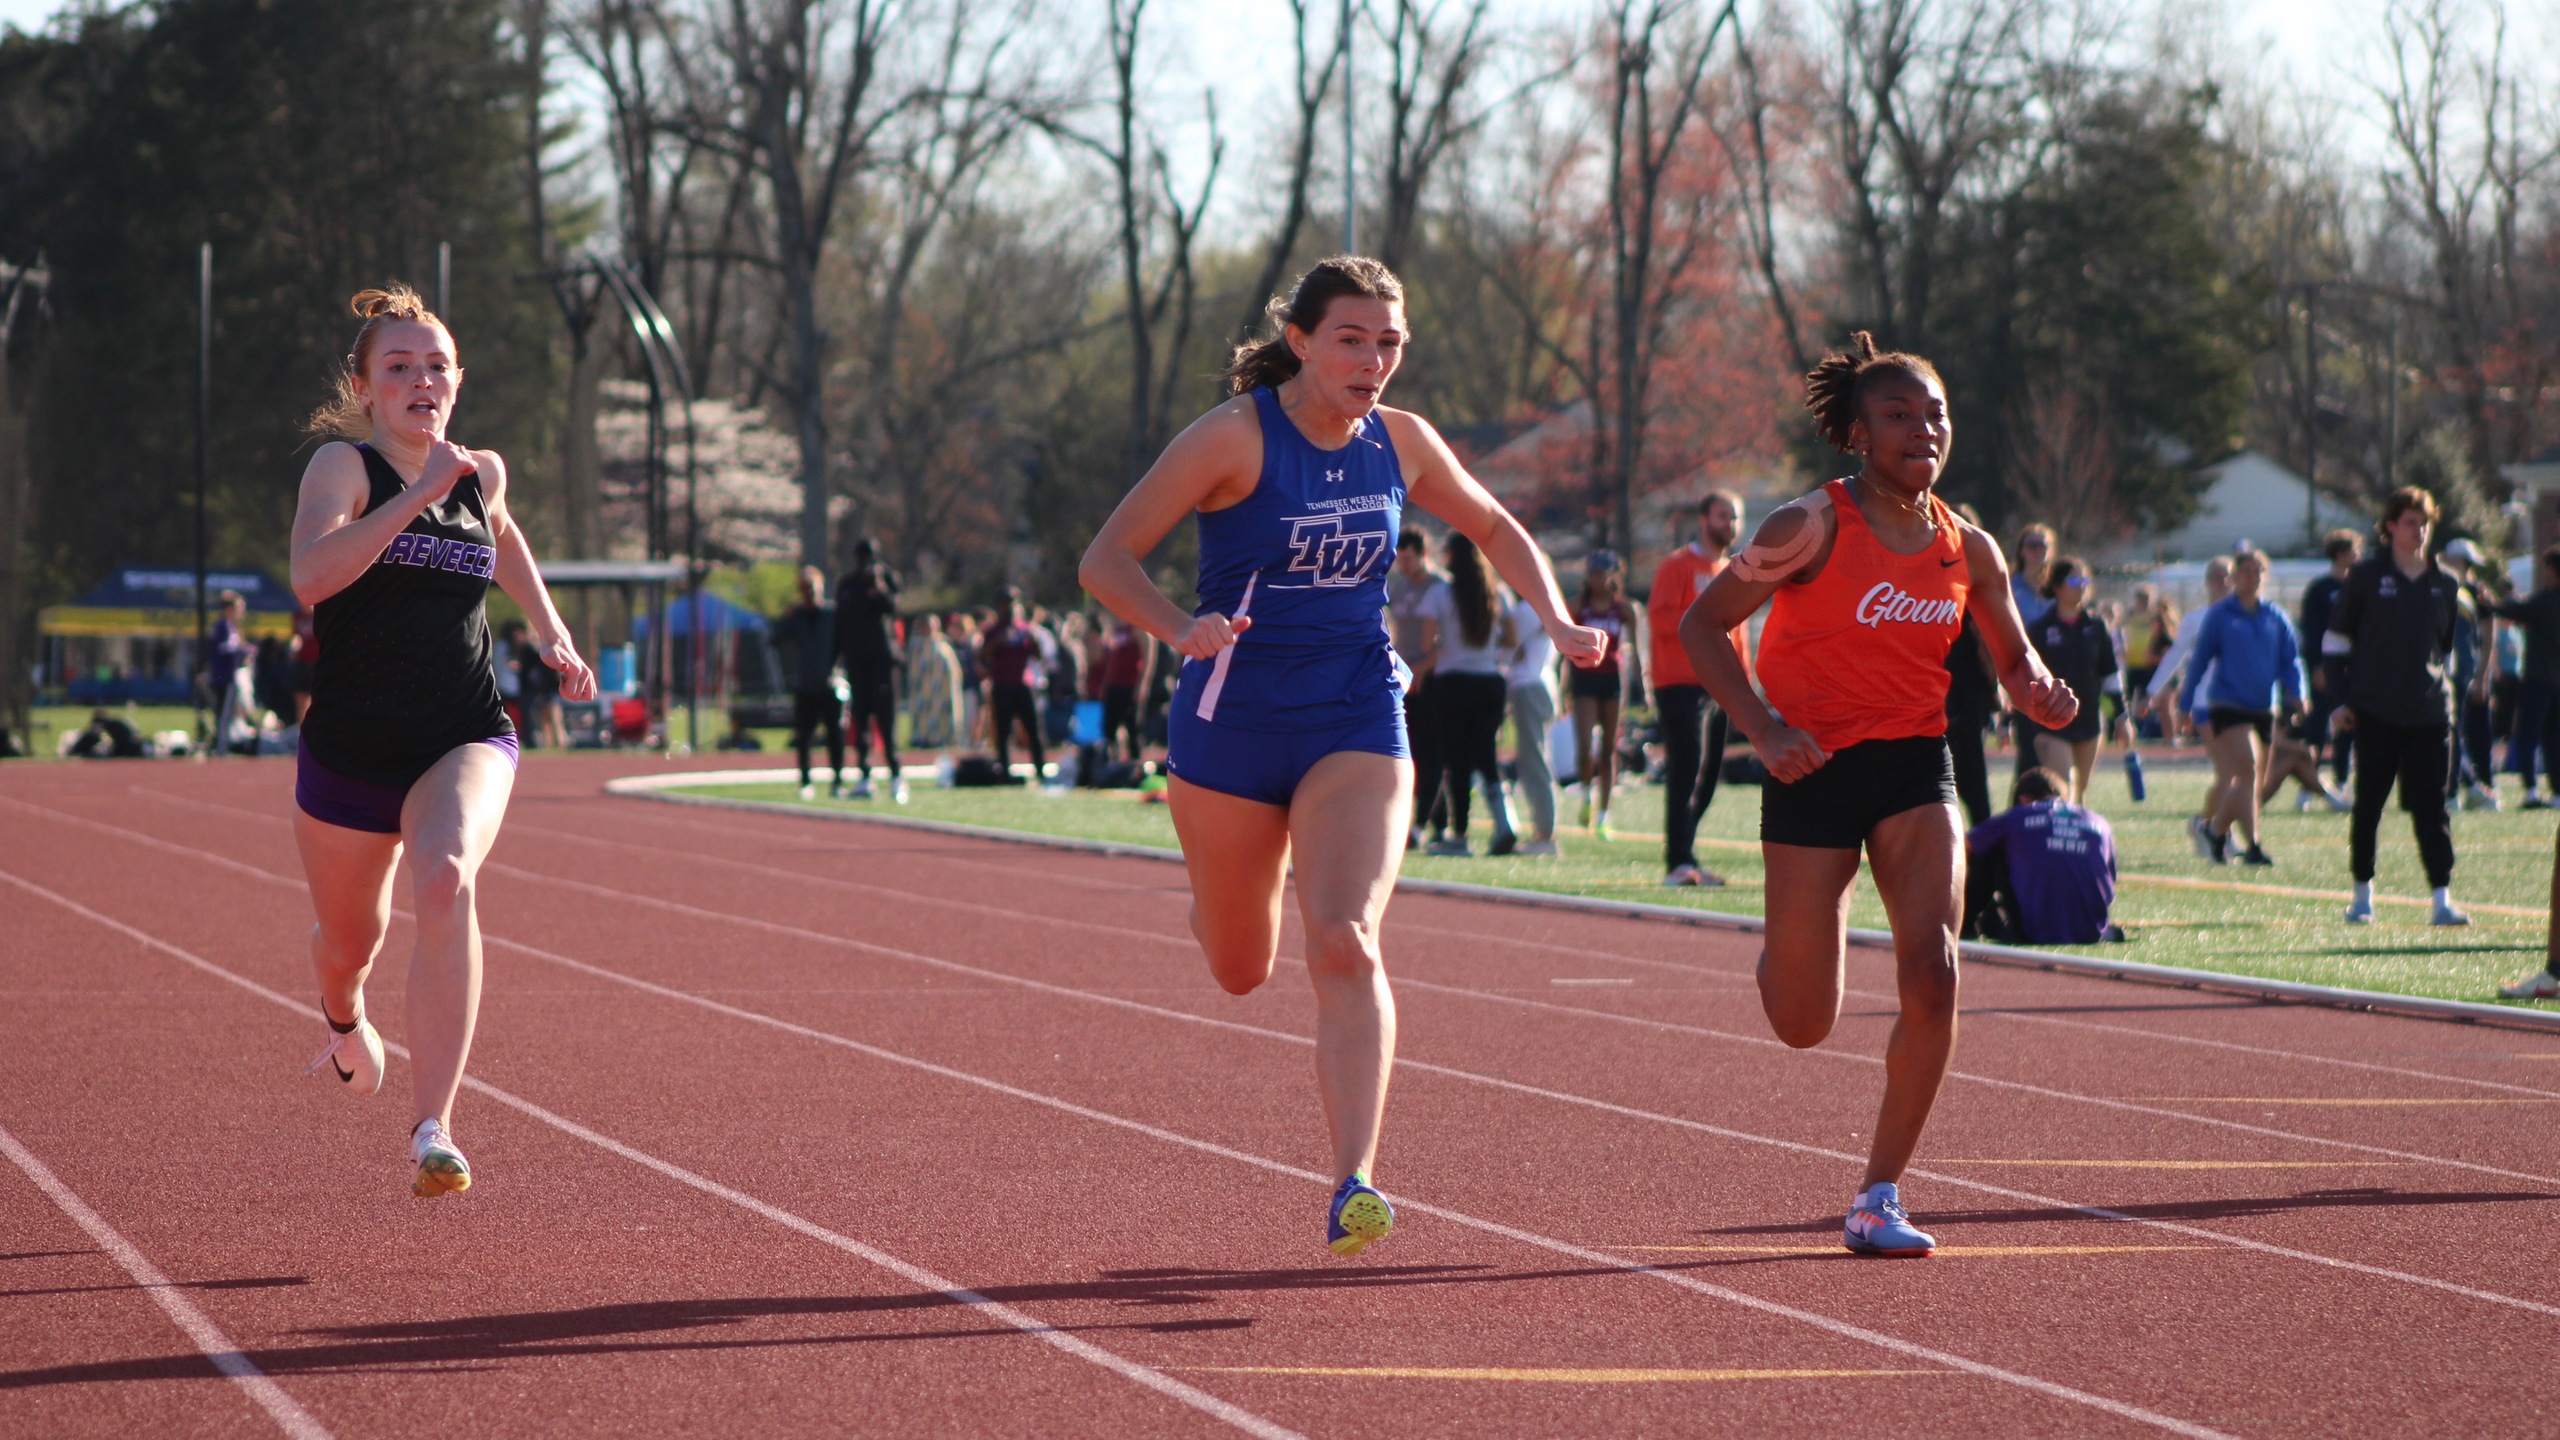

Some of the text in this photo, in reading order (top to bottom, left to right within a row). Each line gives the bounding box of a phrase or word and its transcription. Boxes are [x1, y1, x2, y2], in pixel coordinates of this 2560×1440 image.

[1306, 494, 1388, 510] TENNESSEE WESLEYAN
[1335, 501, 1389, 513] BULLDOGS
[373, 532, 496, 579] REVECCA
[1288, 516, 1387, 585] TW
[1856, 581, 1958, 629] Gtown
